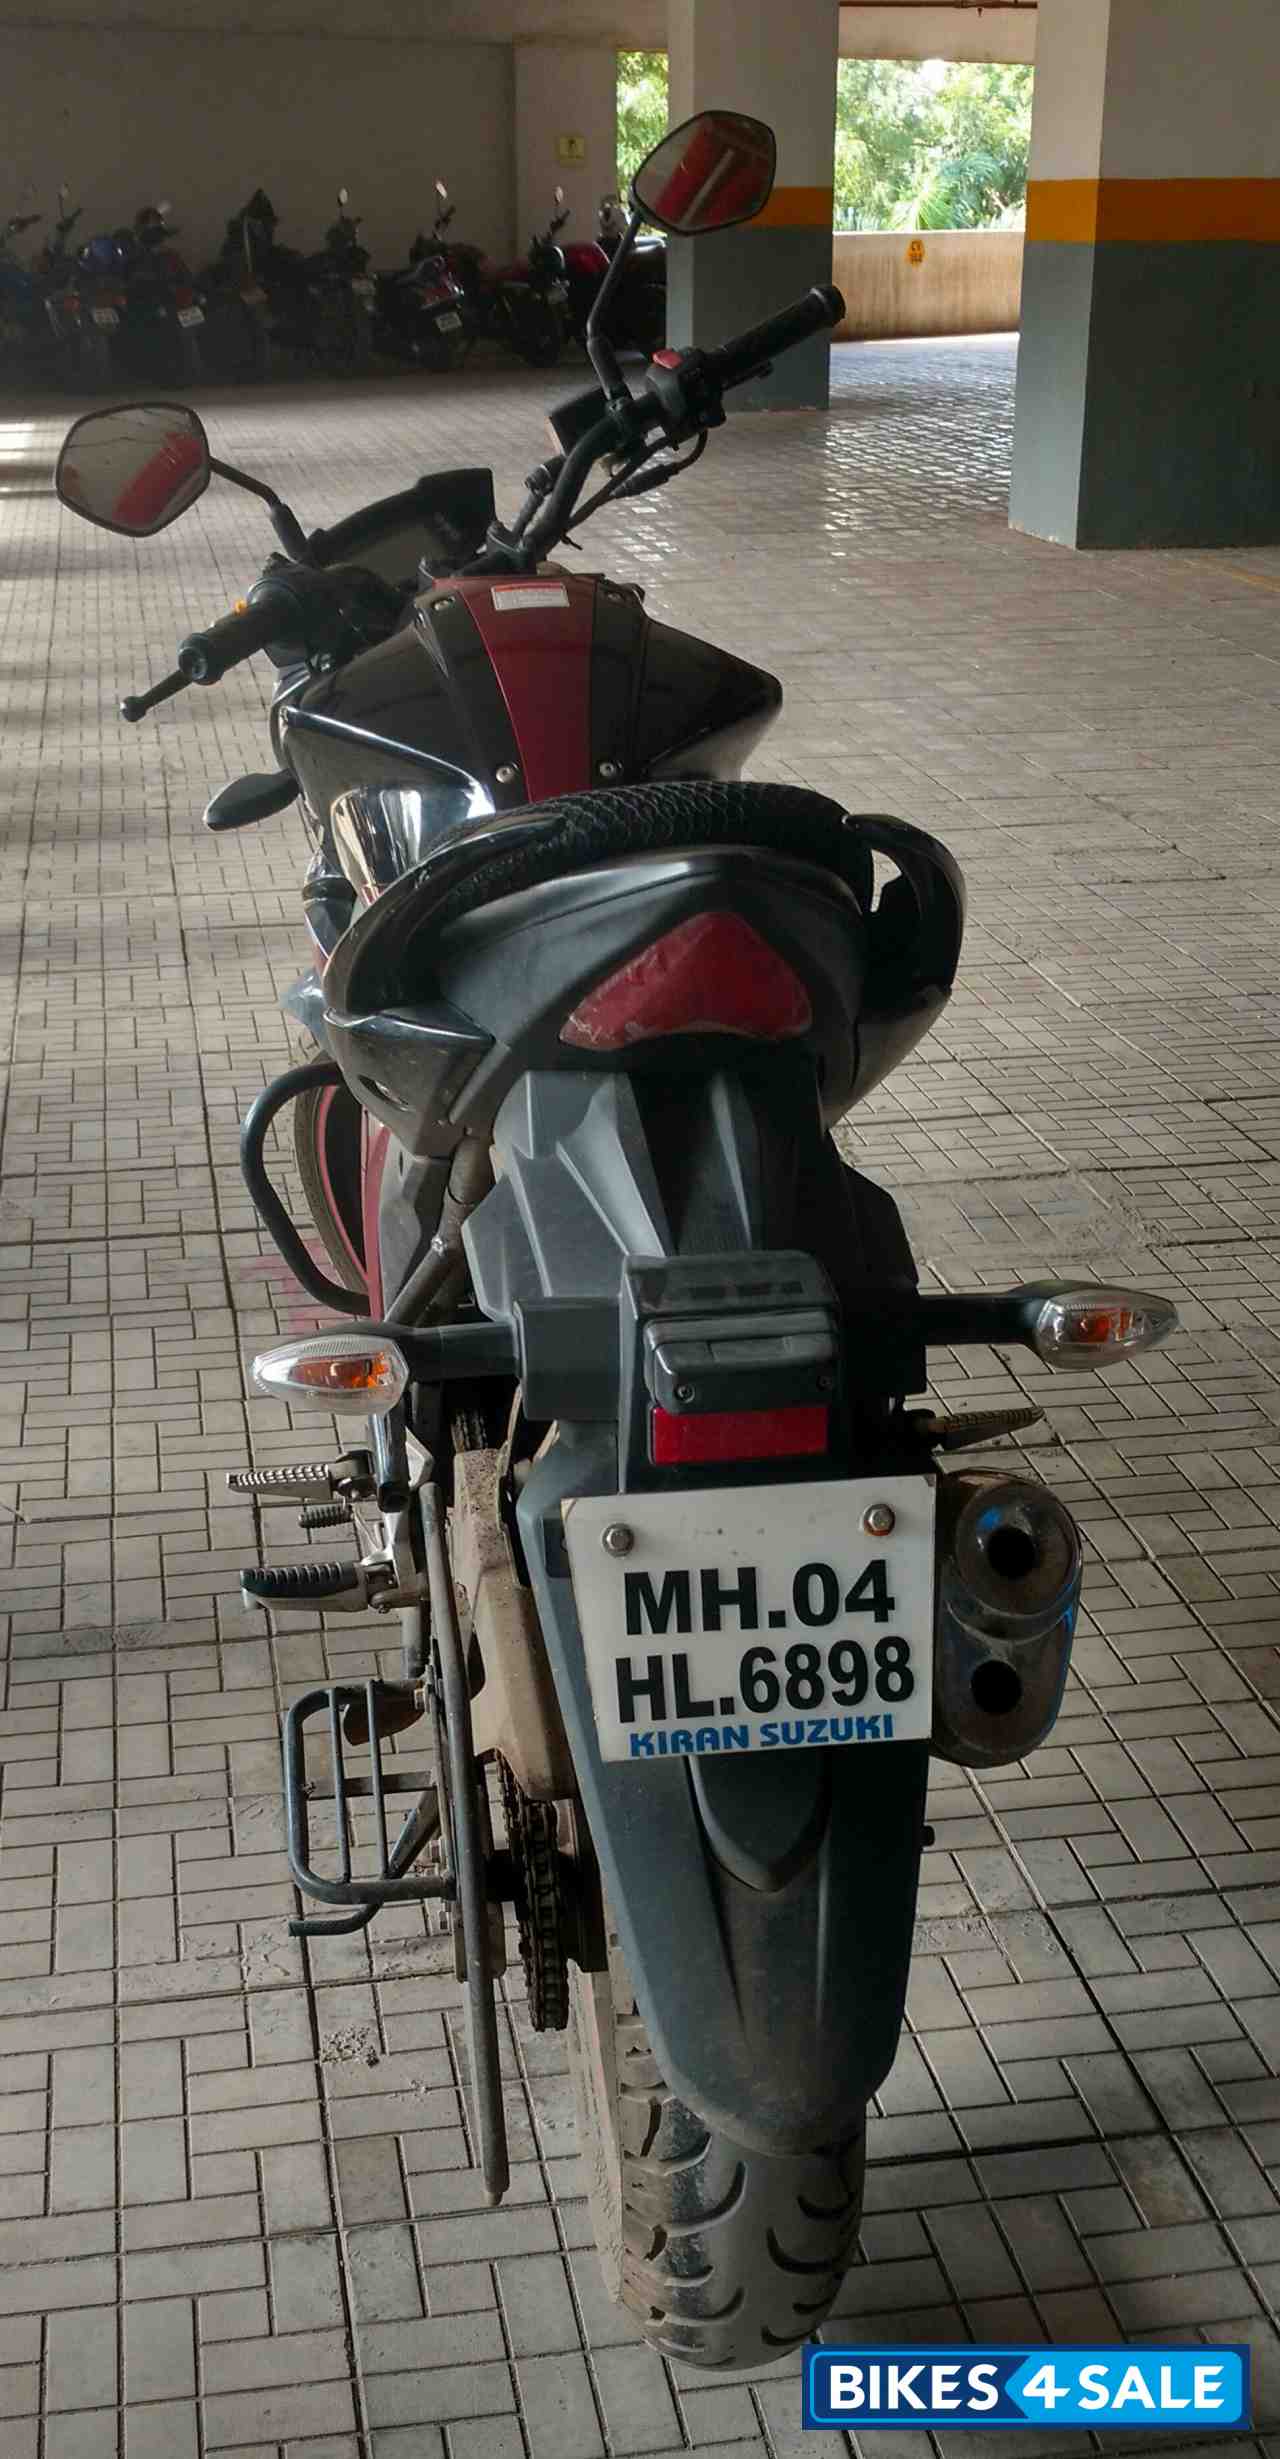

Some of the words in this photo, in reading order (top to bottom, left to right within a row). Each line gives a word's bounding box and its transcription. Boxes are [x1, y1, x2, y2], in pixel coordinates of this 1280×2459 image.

[624, 1559, 895, 1635] MH.04
[615, 1636, 914, 1723] HL.6898
[630, 1724, 750, 1757] KIRAN
[759, 1714, 894, 1747] SUZUKI
